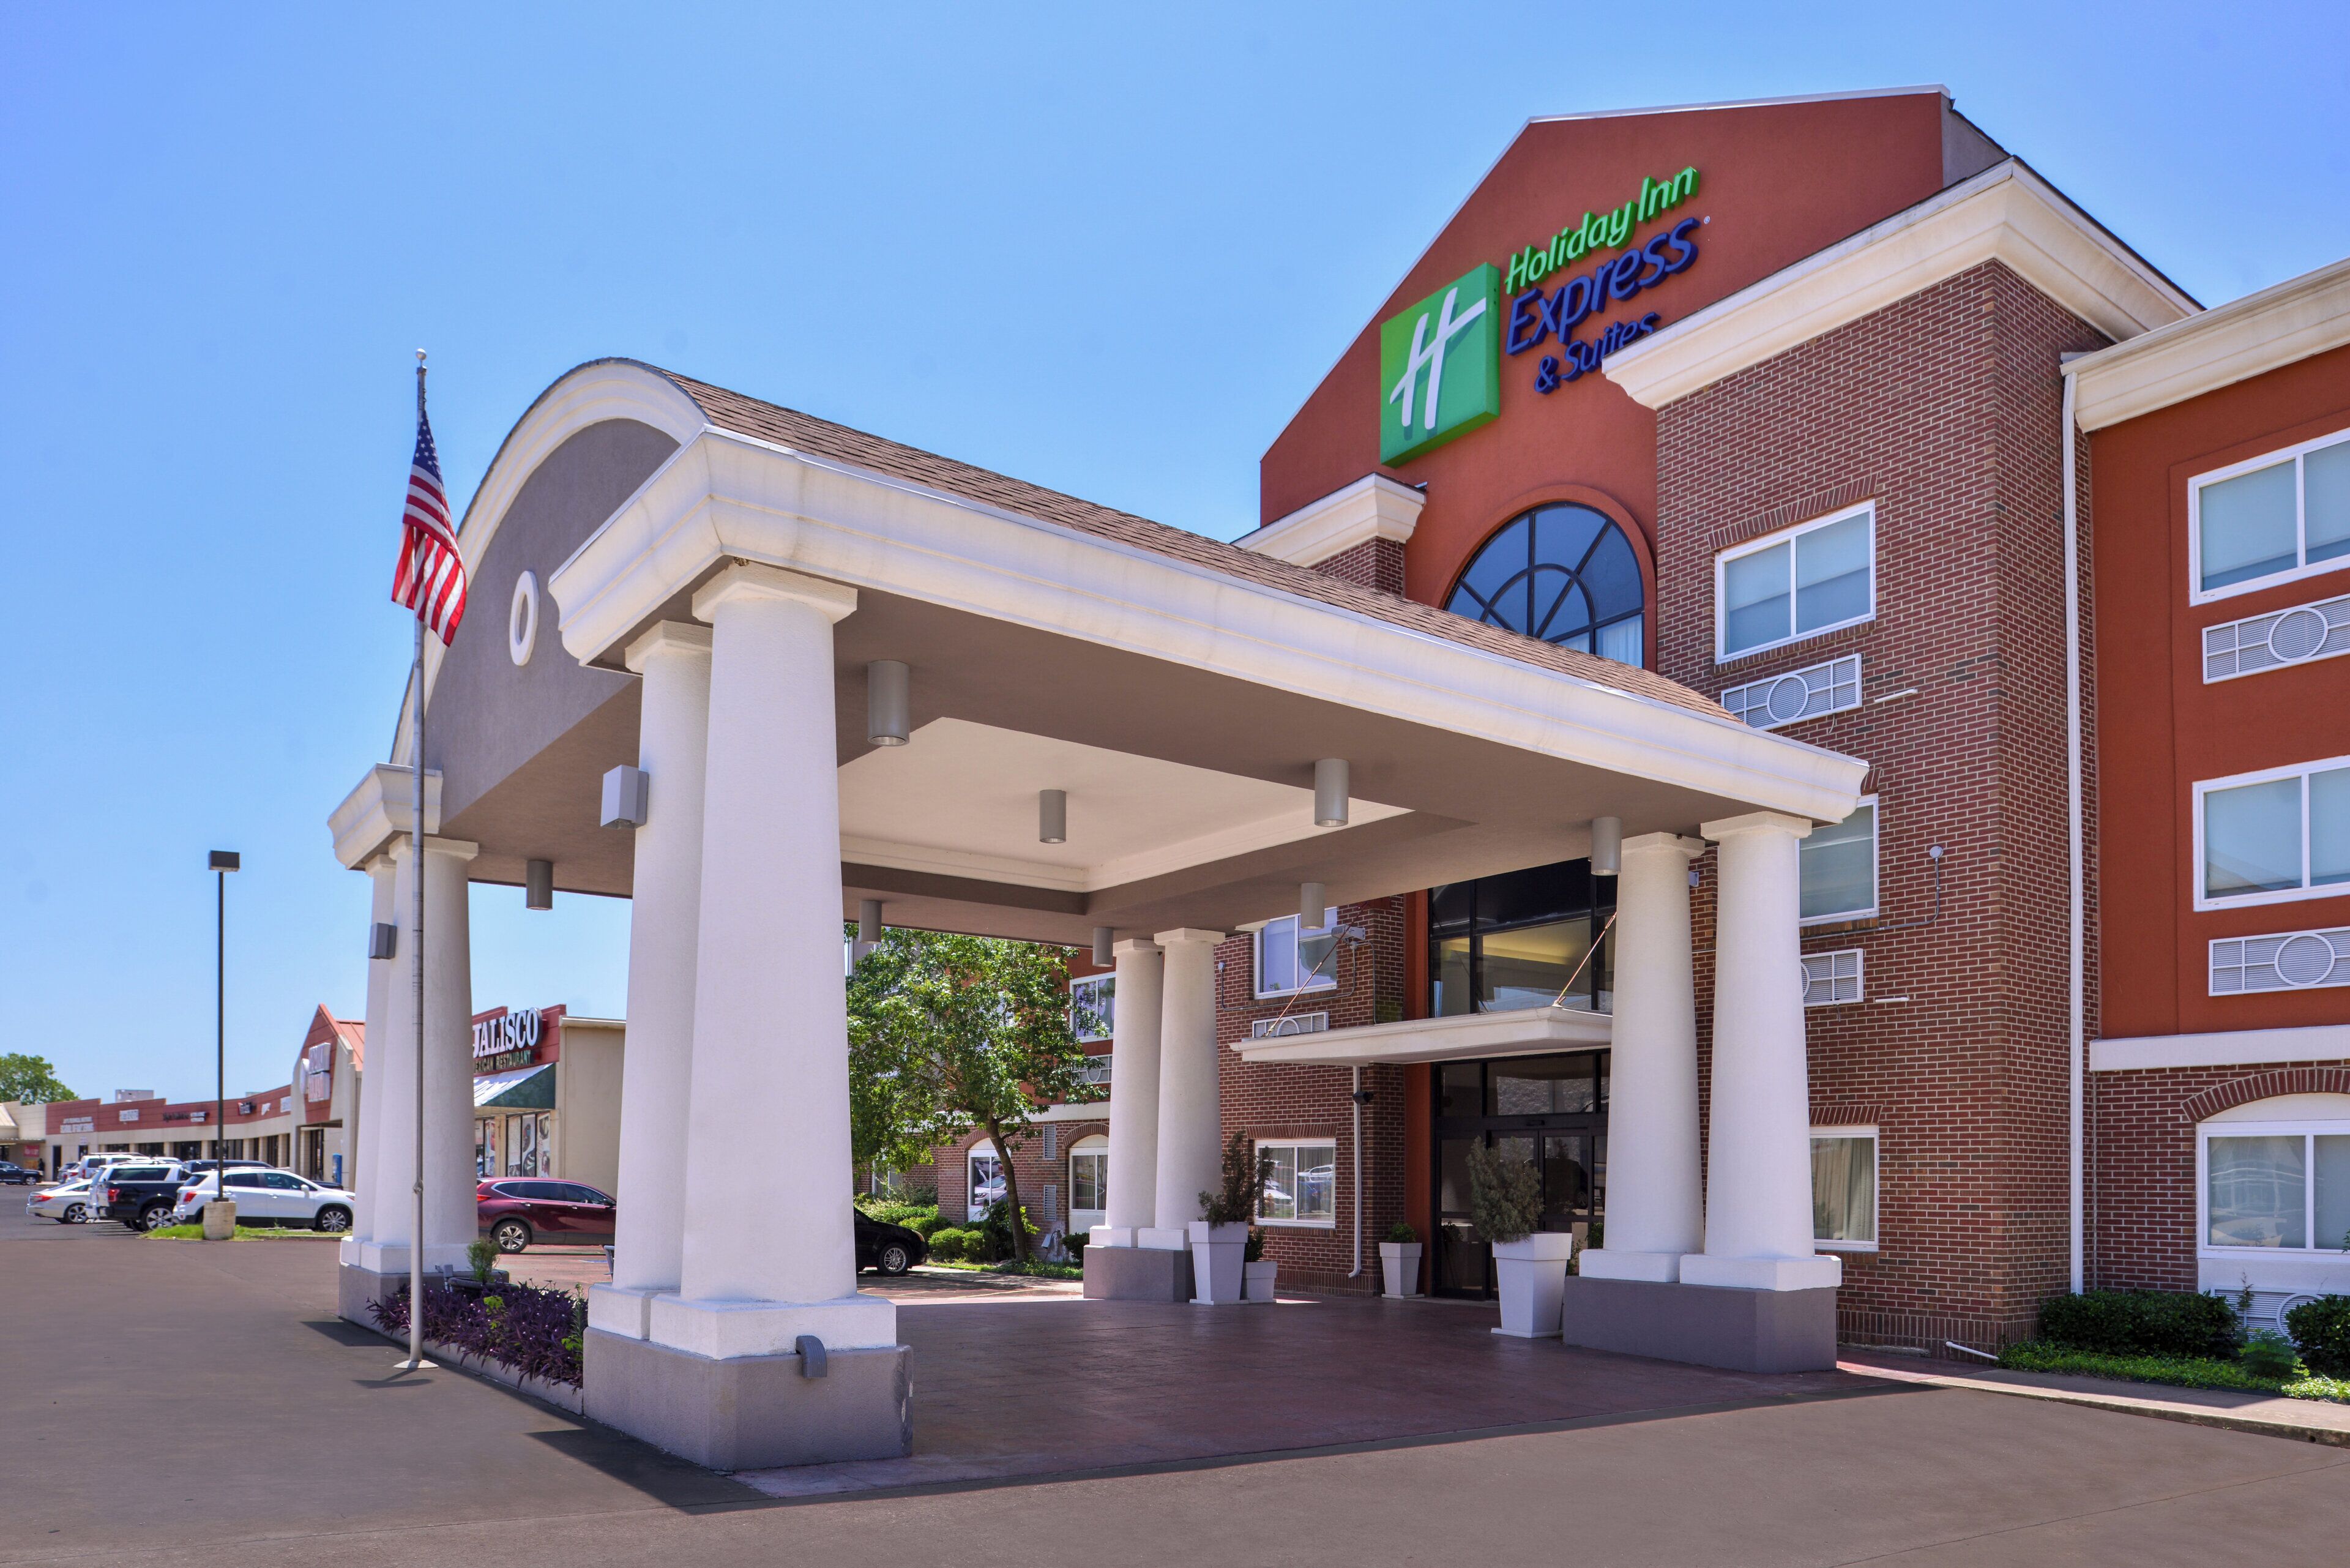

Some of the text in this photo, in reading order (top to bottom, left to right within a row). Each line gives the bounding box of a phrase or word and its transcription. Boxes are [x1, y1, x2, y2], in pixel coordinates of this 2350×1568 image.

[1505, 166, 1700, 297] Holiday Inn
[1505, 217, 1701, 356] Express
[1389, 286, 1487, 430] H
[1534, 312, 1662, 395] & Suites
[472, 1007, 540, 1059] JALISCO
[473, 1049, 531, 1074] EXICAN RESTAURANT
